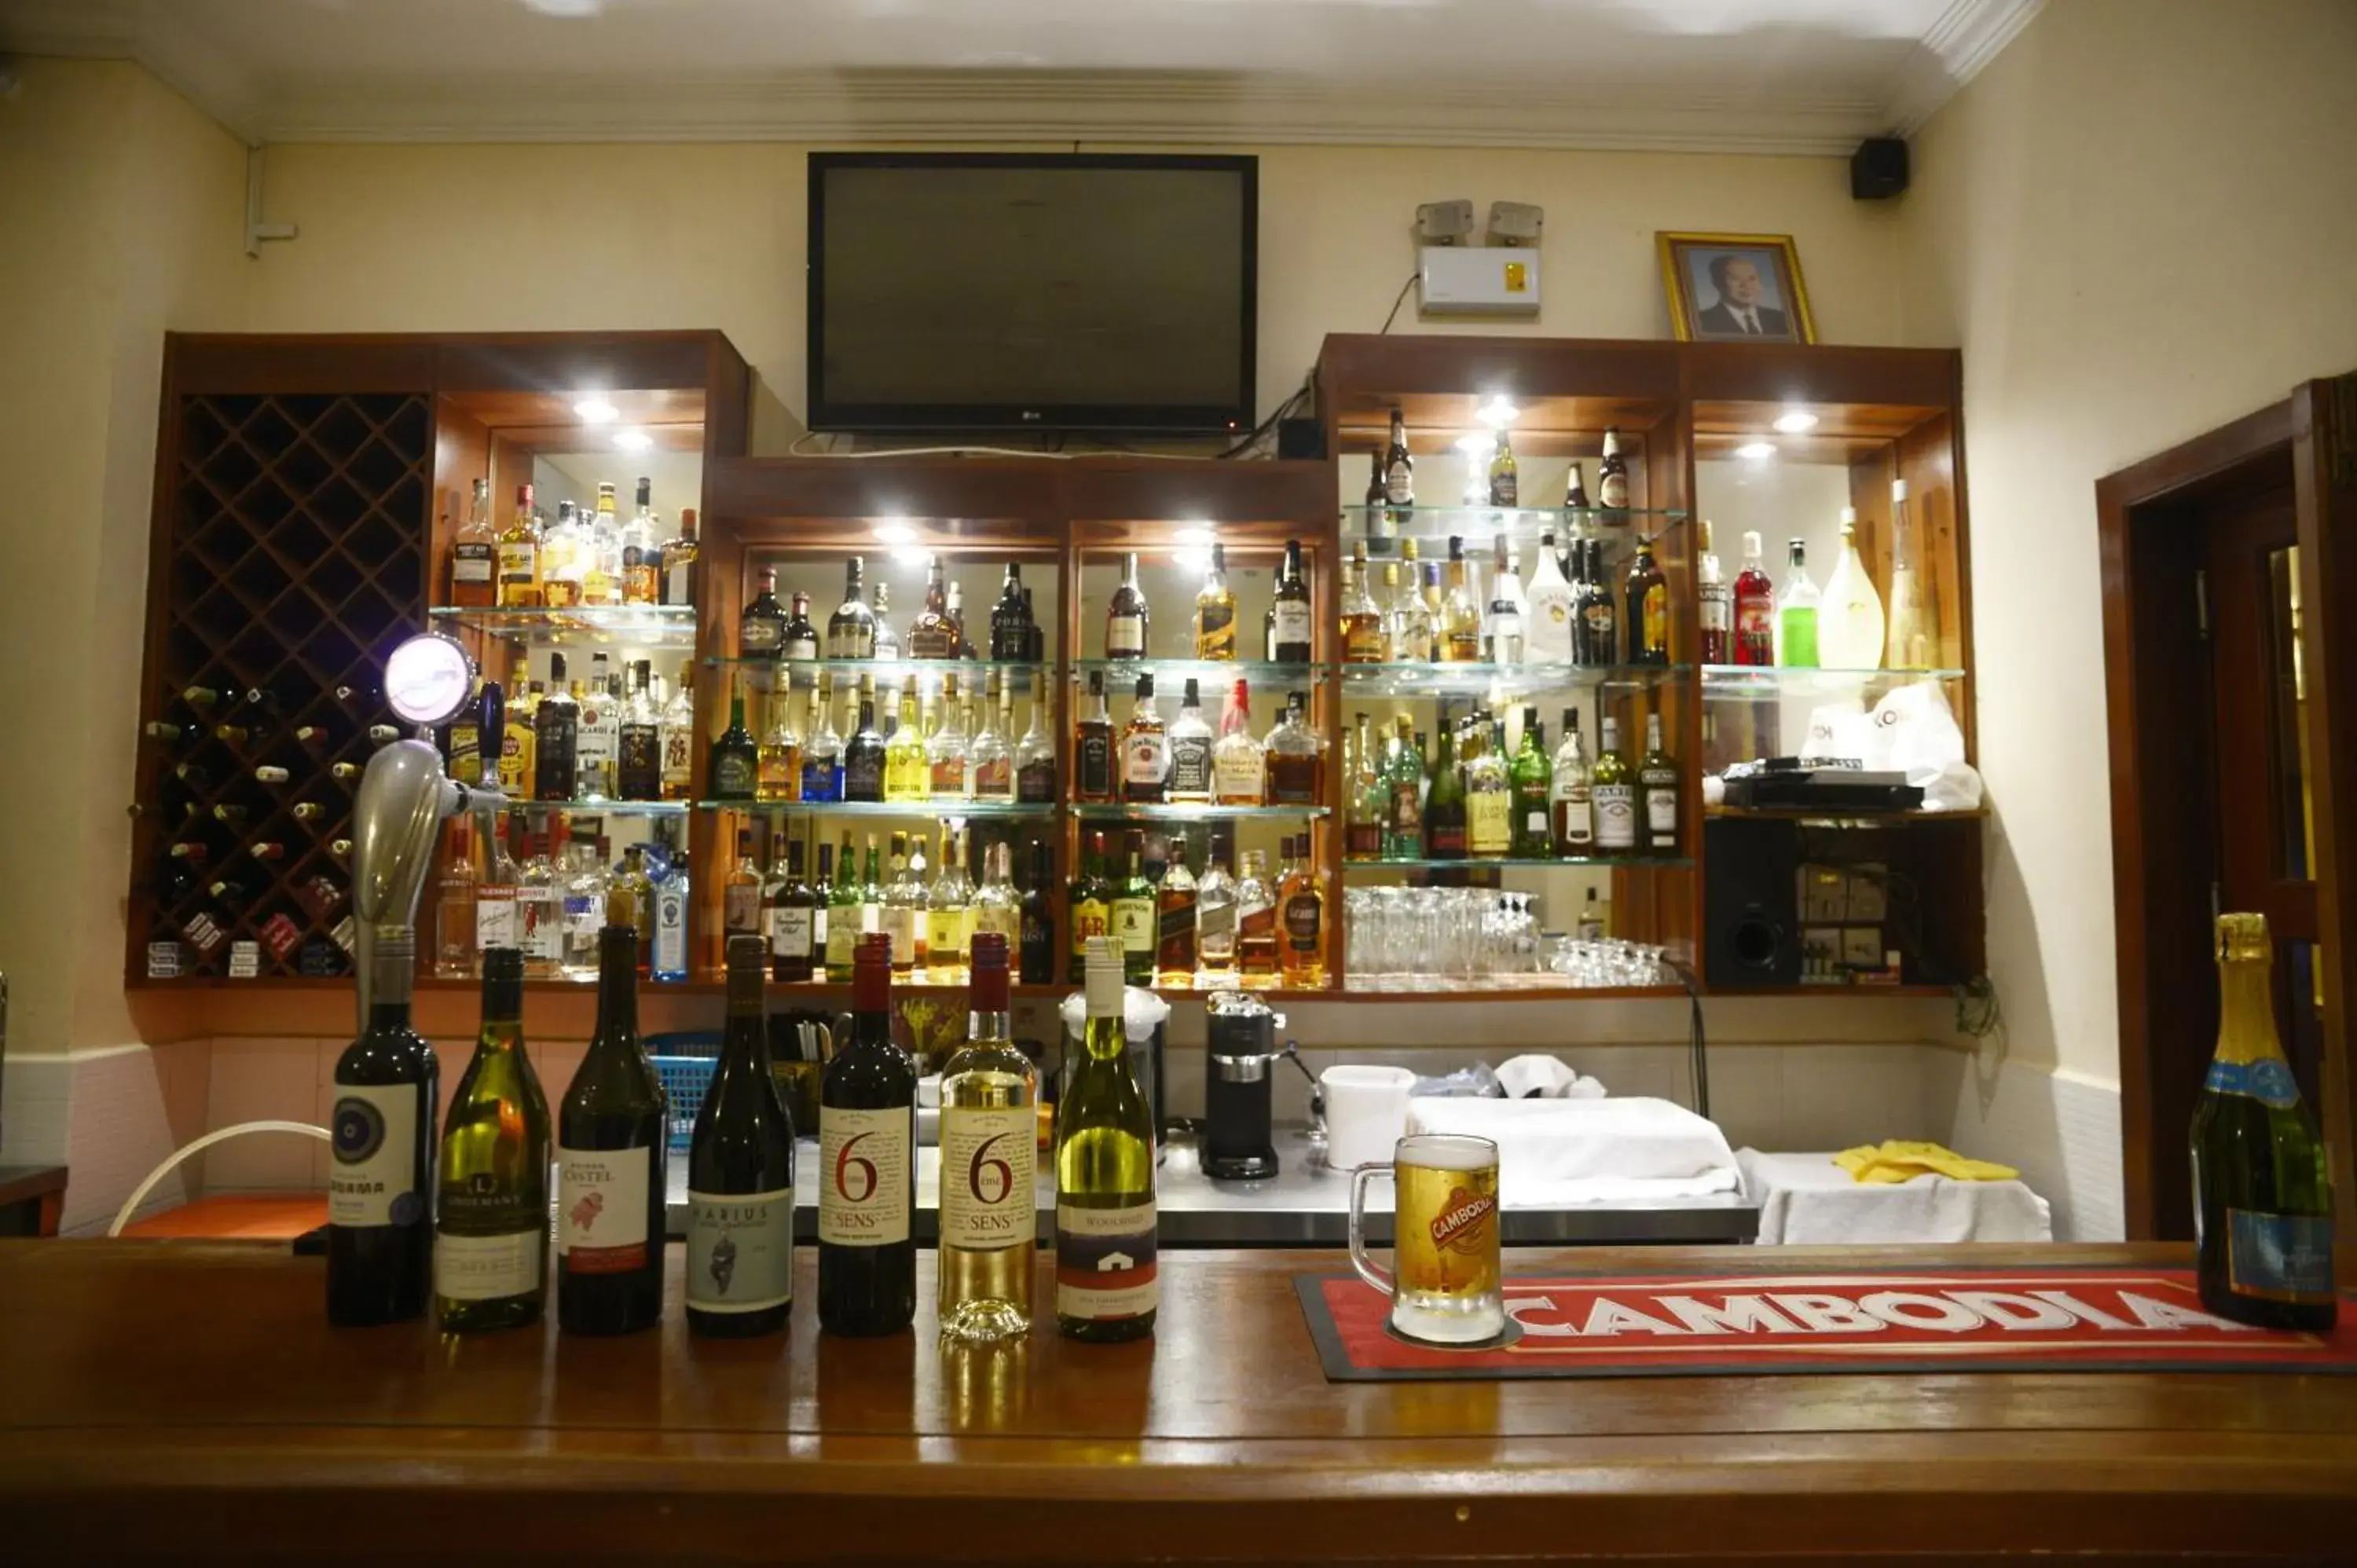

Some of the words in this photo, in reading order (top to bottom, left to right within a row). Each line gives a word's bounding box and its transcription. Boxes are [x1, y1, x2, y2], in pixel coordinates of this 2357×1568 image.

[835, 1131, 878, 1203] 6
[969, 1132, 1013, 1204] 6
[837, 1213, 875, 1228] SENS
[970, 1214, 1010, 1231] SENS
